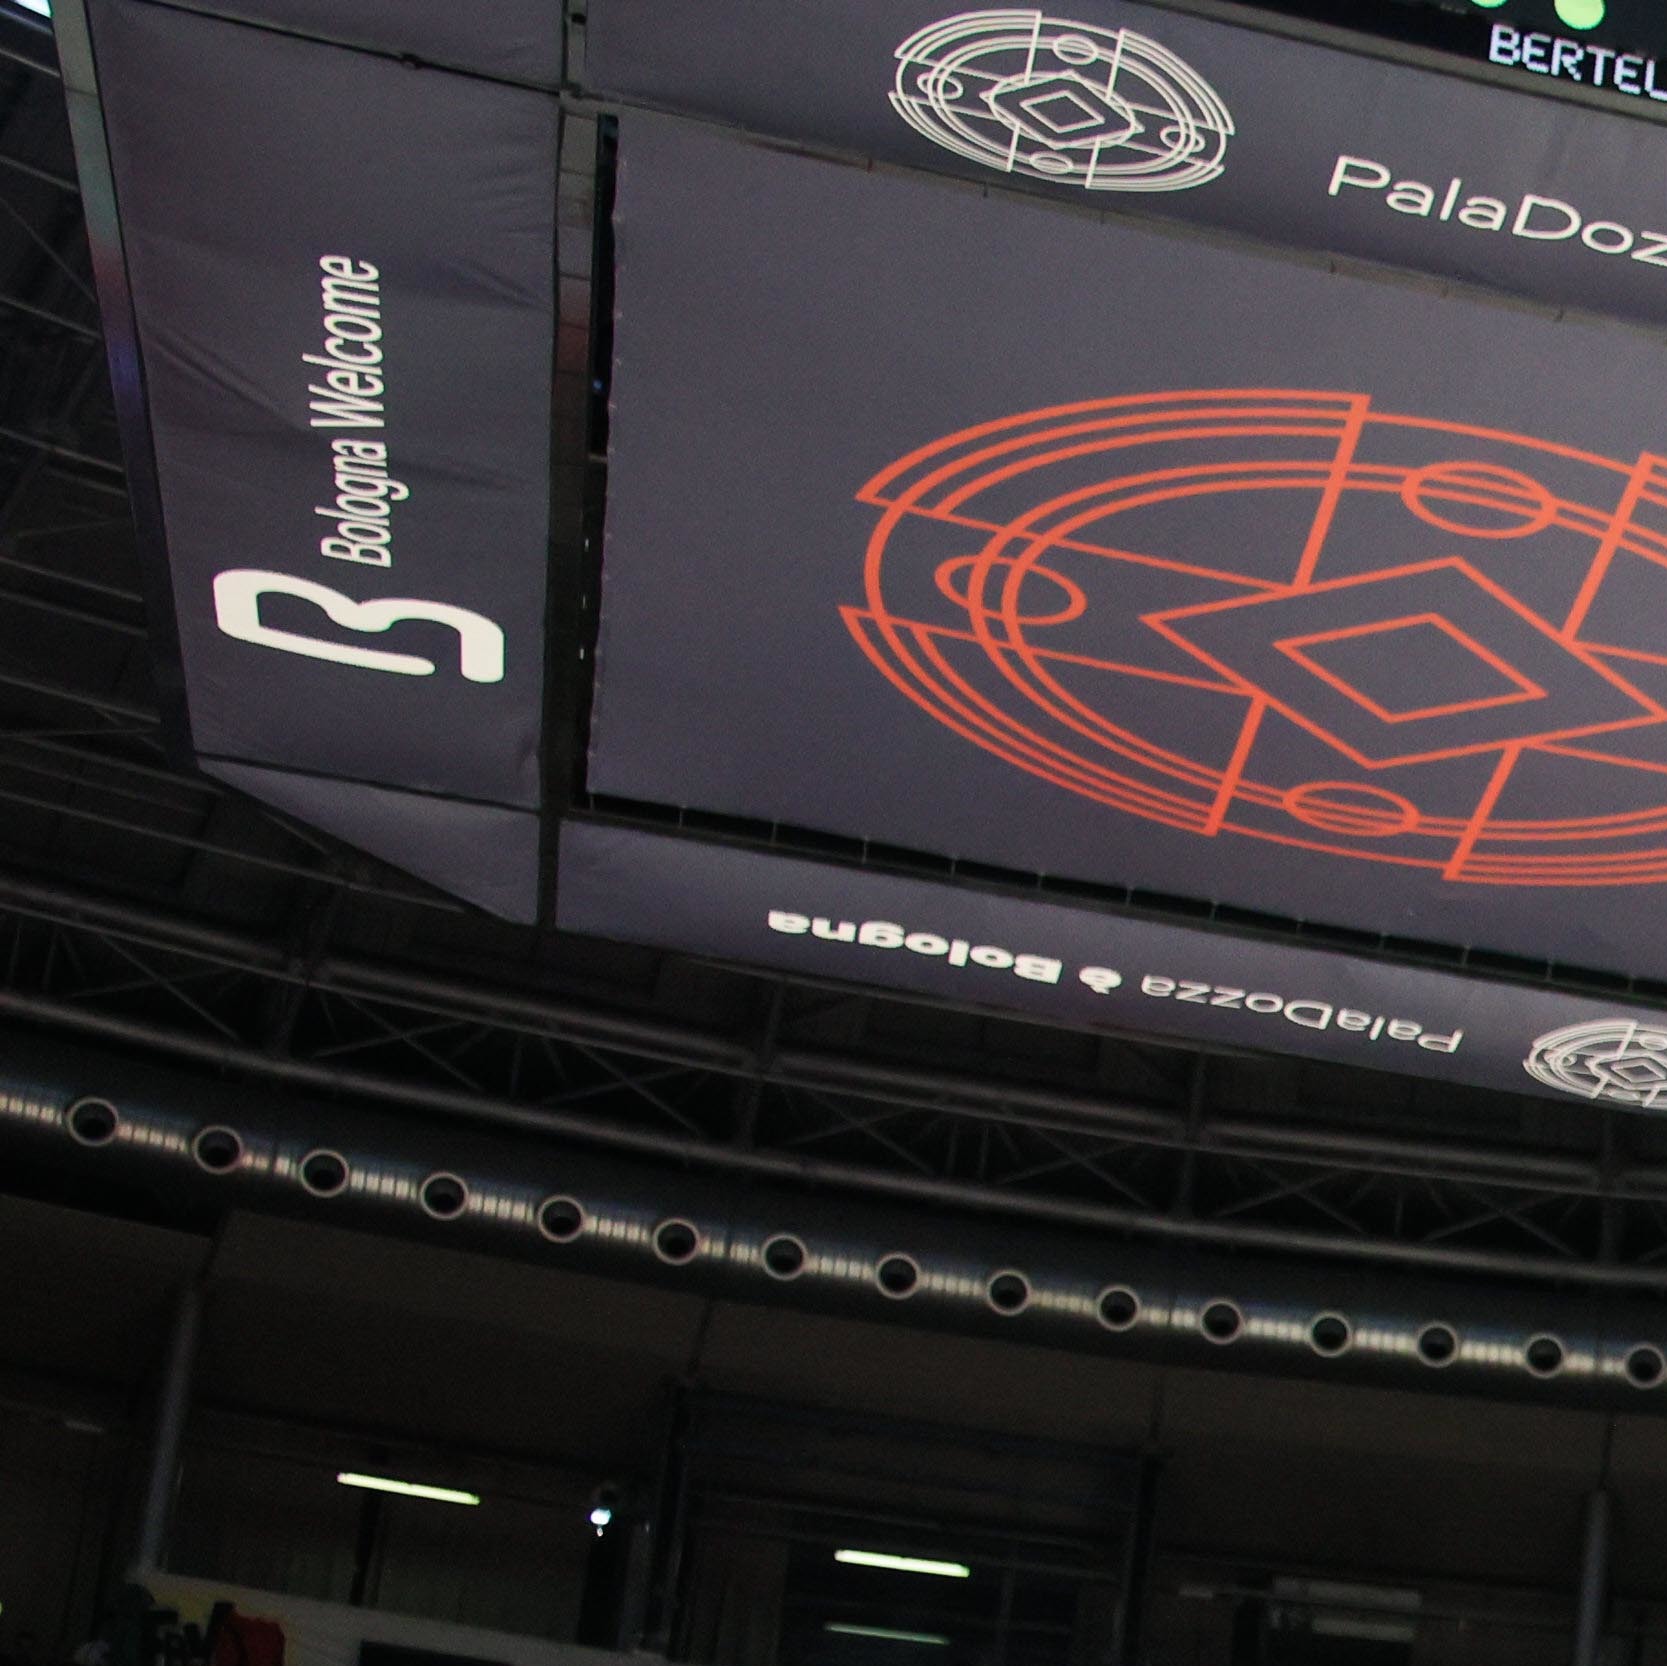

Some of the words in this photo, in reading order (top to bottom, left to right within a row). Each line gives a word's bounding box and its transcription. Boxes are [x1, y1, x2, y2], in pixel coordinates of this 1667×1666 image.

[302, 254, 385, 429] Welcome
[314, 438, 410, 568] Bologna
[767, 909, 1061, 985] Bologna
[1140, 972, 1463, 1054] PalaDozza
